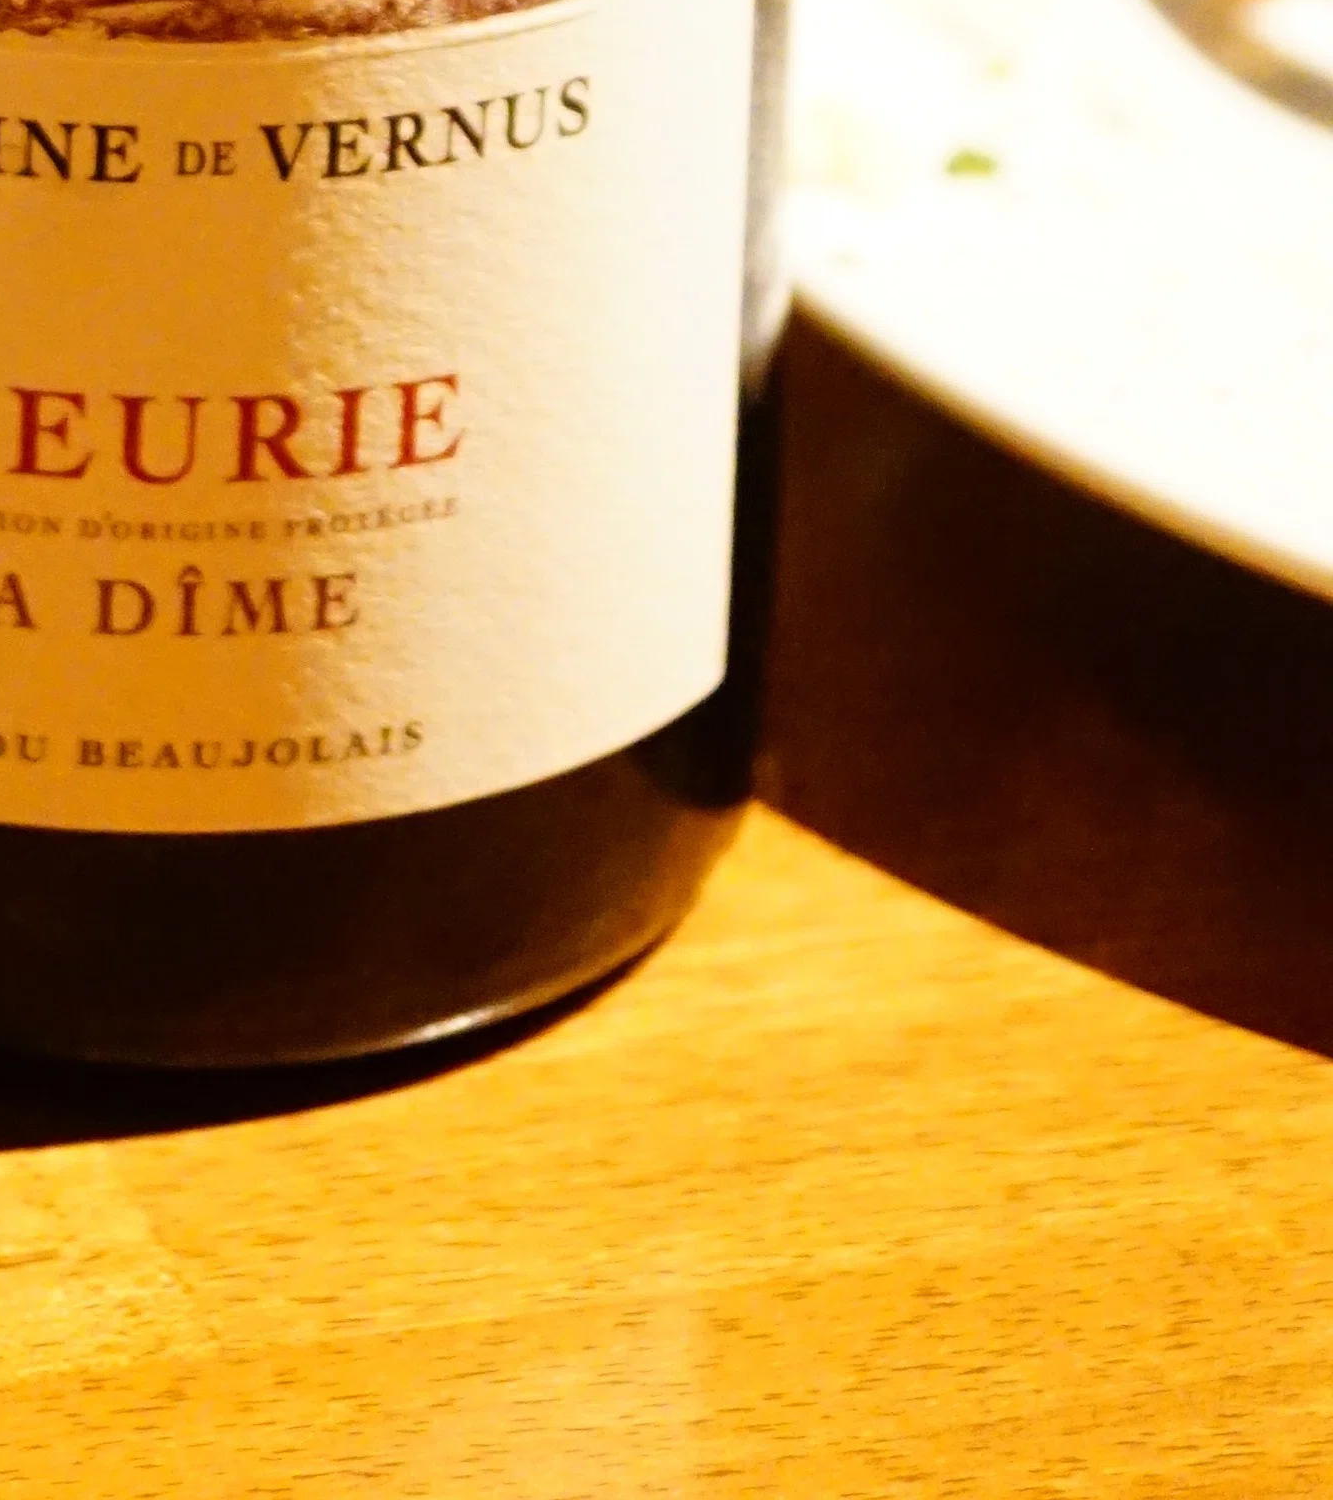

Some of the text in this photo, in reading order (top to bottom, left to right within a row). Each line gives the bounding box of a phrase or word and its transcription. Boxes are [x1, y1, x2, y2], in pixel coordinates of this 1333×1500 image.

[175, 139, 236, 179] DE
[259, 74, 593, 183] VERNUS
[91, 563, 361, 637] DÎME
[74, 719, 425, 770] BEAUJOLAIS
